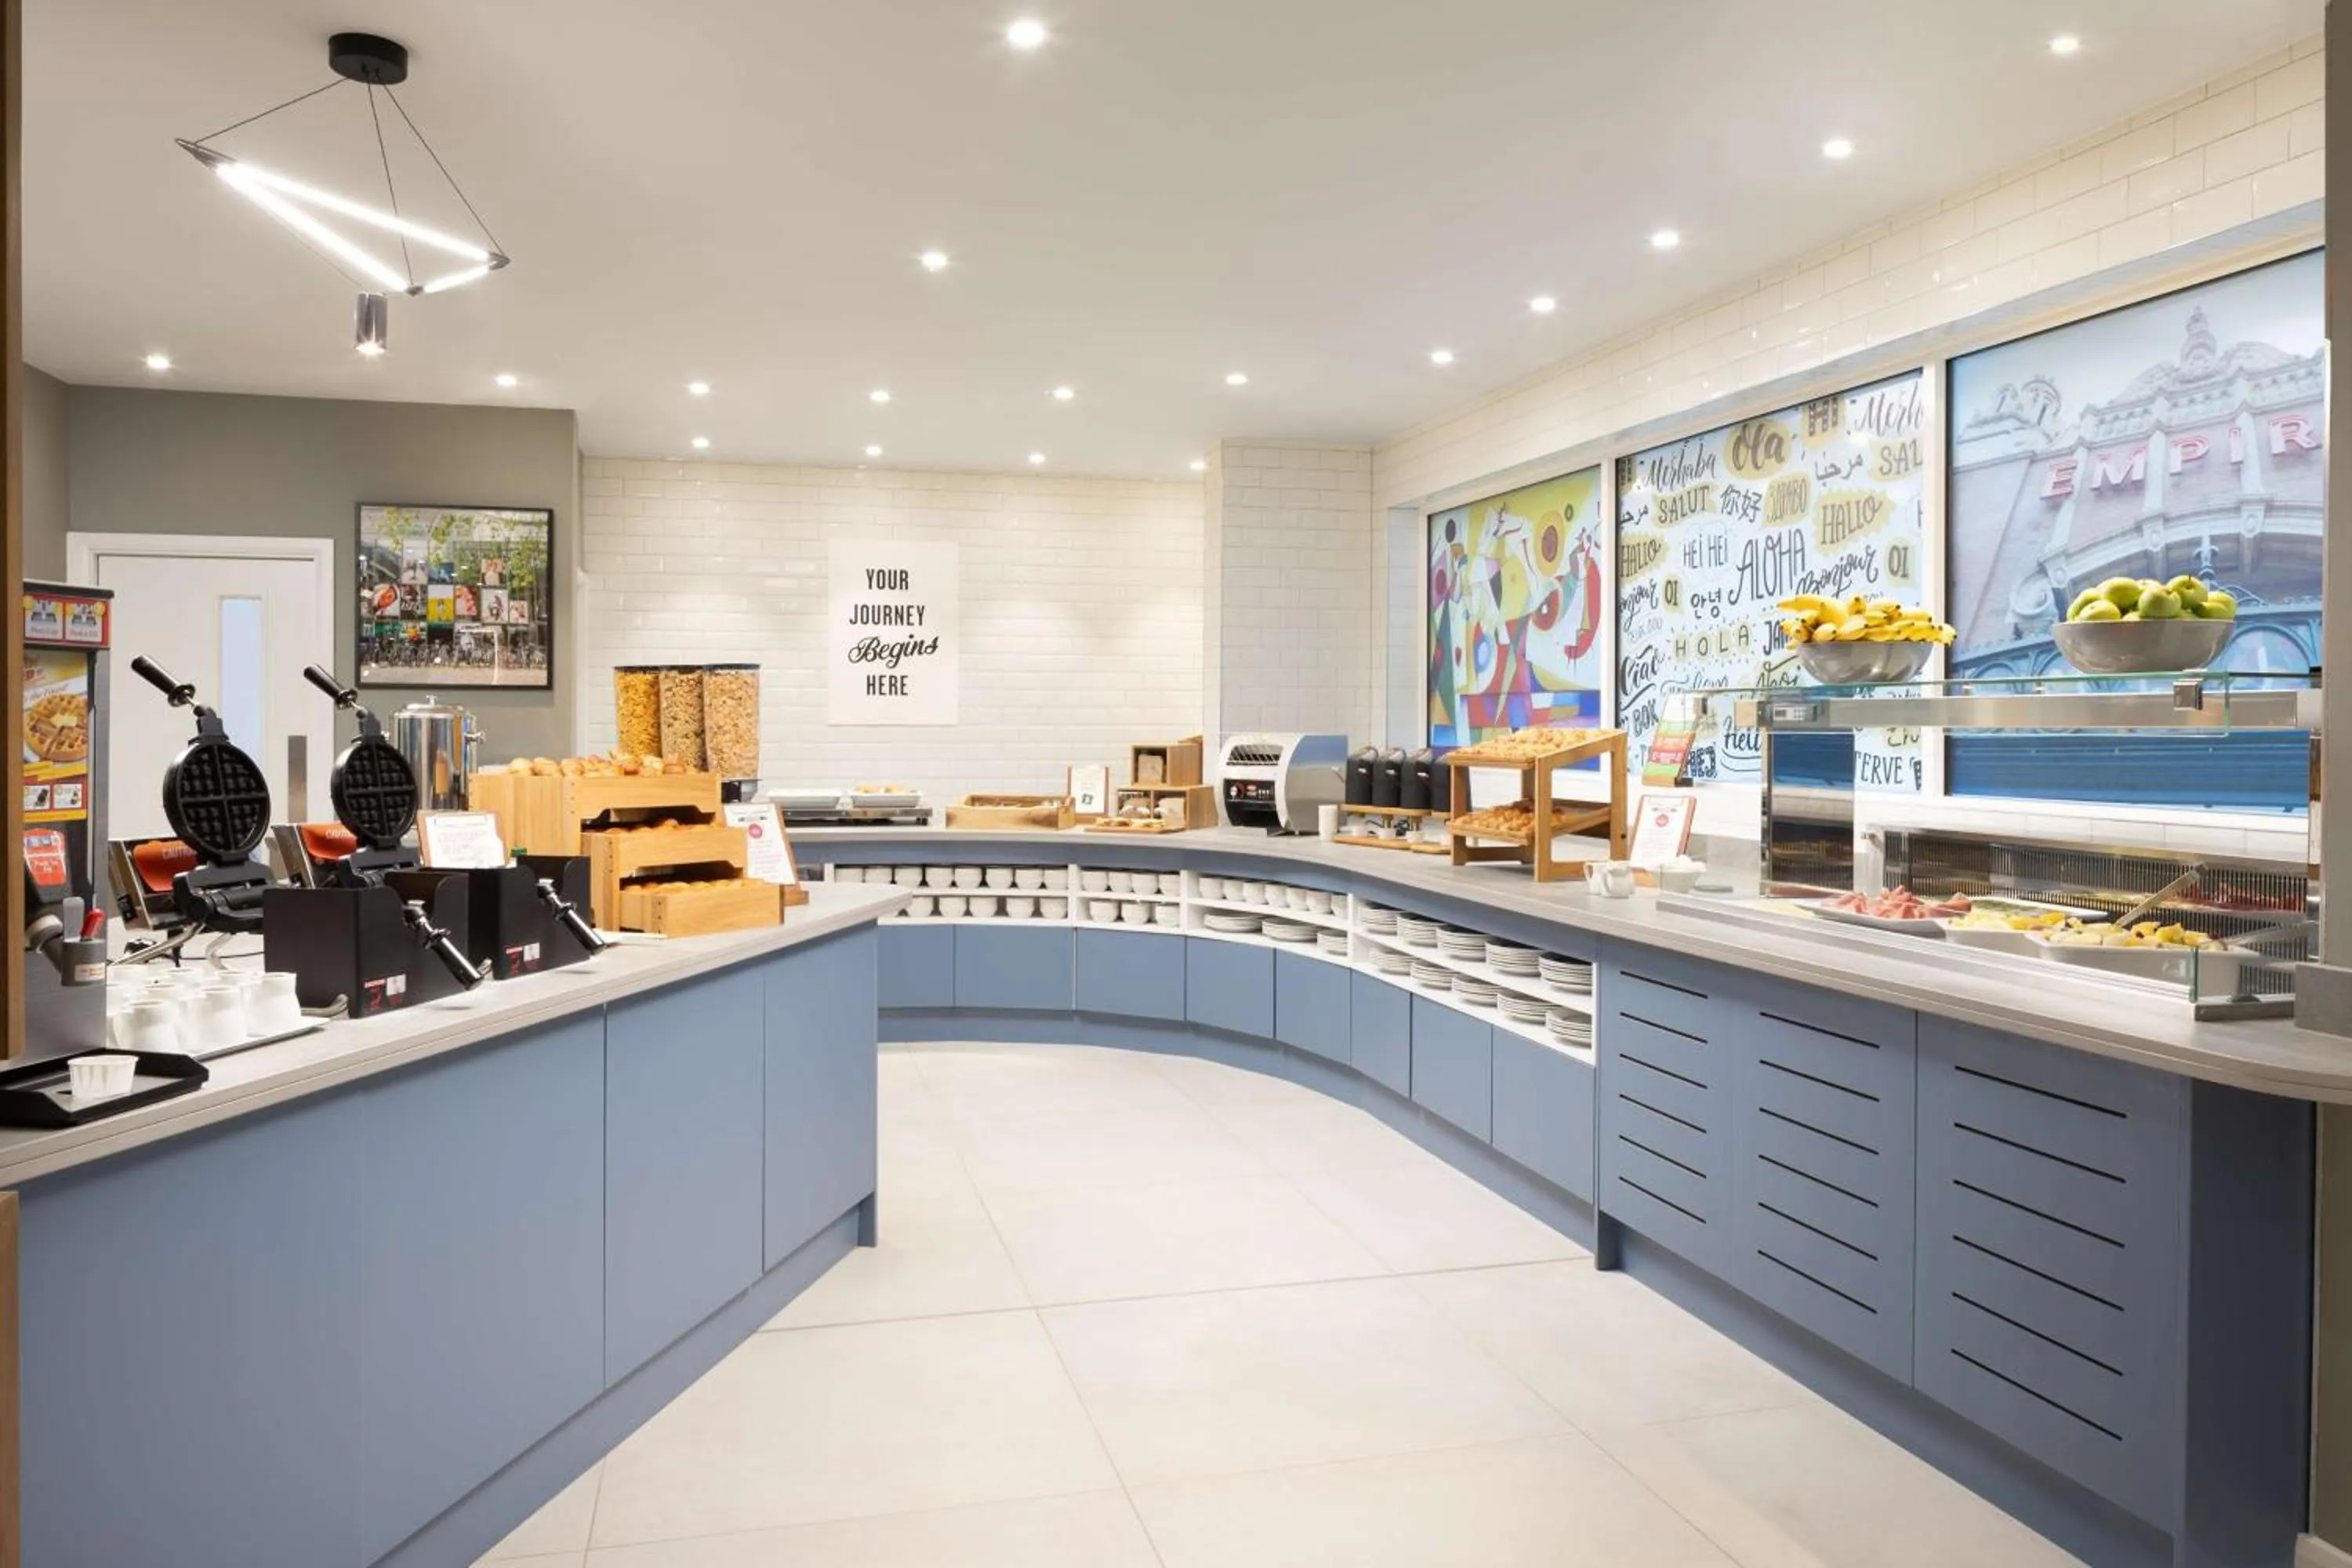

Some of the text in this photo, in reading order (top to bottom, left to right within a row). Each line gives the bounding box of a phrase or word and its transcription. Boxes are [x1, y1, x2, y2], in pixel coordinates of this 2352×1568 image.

[1809, 397, 1838, 437] HI
[2040, 415, 2322, 499] EMPIR
[1658, 485, 1709, 524] SALUT
[1720, 484, 1762, 523] 你好
[1820, 495, 1883, 545] HALLO
[866, 568, 909, 590] YOUR
[1728, 528, 1806, 606] ALOHA
[1888, 546, 1910, 578] OI
[1664, 580, 1679, 606] OI
[849, 604, 926, 626] JOURNEY
[848, 633, 939, 670] Begins
[1675, 625, 1749, 657] HOLA
[866, 674, 909, 696] HERE
